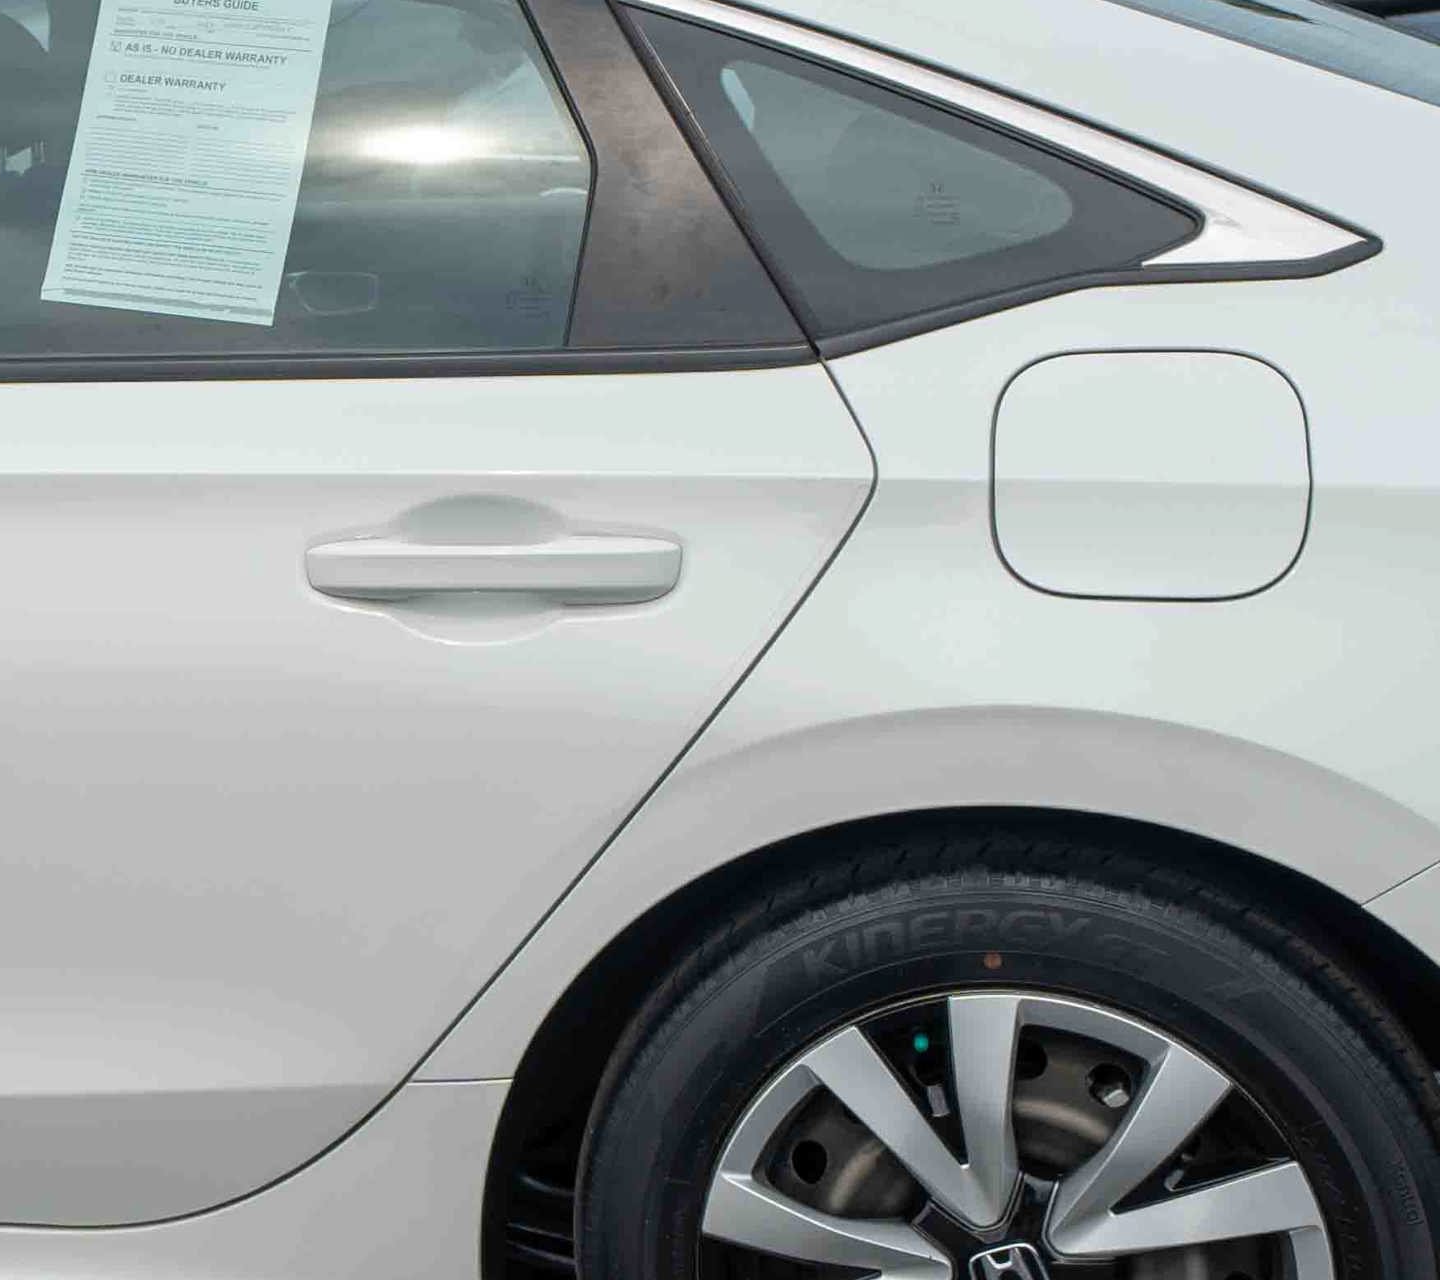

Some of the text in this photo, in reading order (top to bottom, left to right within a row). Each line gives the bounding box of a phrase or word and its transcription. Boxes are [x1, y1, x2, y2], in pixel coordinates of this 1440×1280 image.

[124, 42, 140, 53] AS
[142, 43, 153, 54] IS
[161, 44, 178, 56] NO
[178, 46, 223, 60] DEALER
[224, 50, 288, 65] WARRANTY
[119, 73, 228, 92] DEALER WARRANTY
